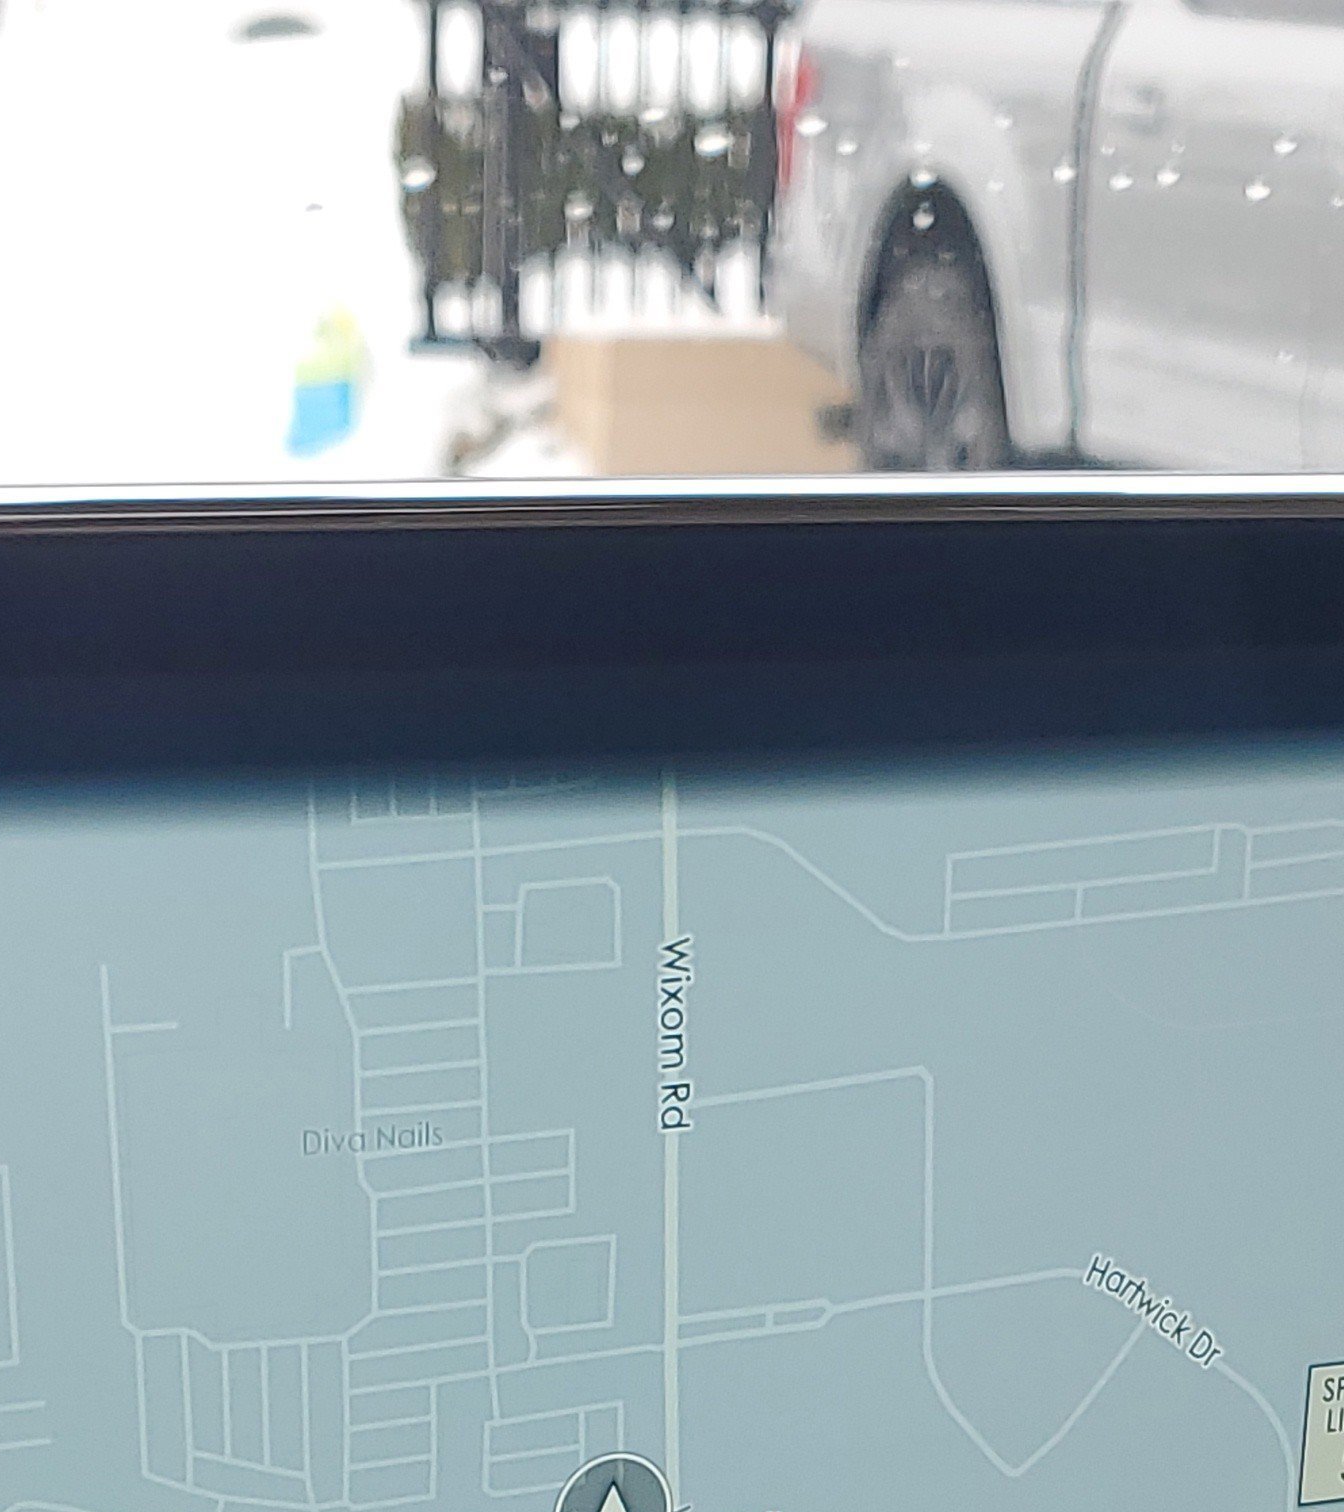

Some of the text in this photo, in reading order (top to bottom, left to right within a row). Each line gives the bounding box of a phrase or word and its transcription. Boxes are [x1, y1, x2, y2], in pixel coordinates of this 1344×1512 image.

[660, 937, 692, 1131] Wixom Rd
[303, 1121, 444, 1156] Diva Nails
[1086, 1256, 1222, 1366] Hartwick Dr
